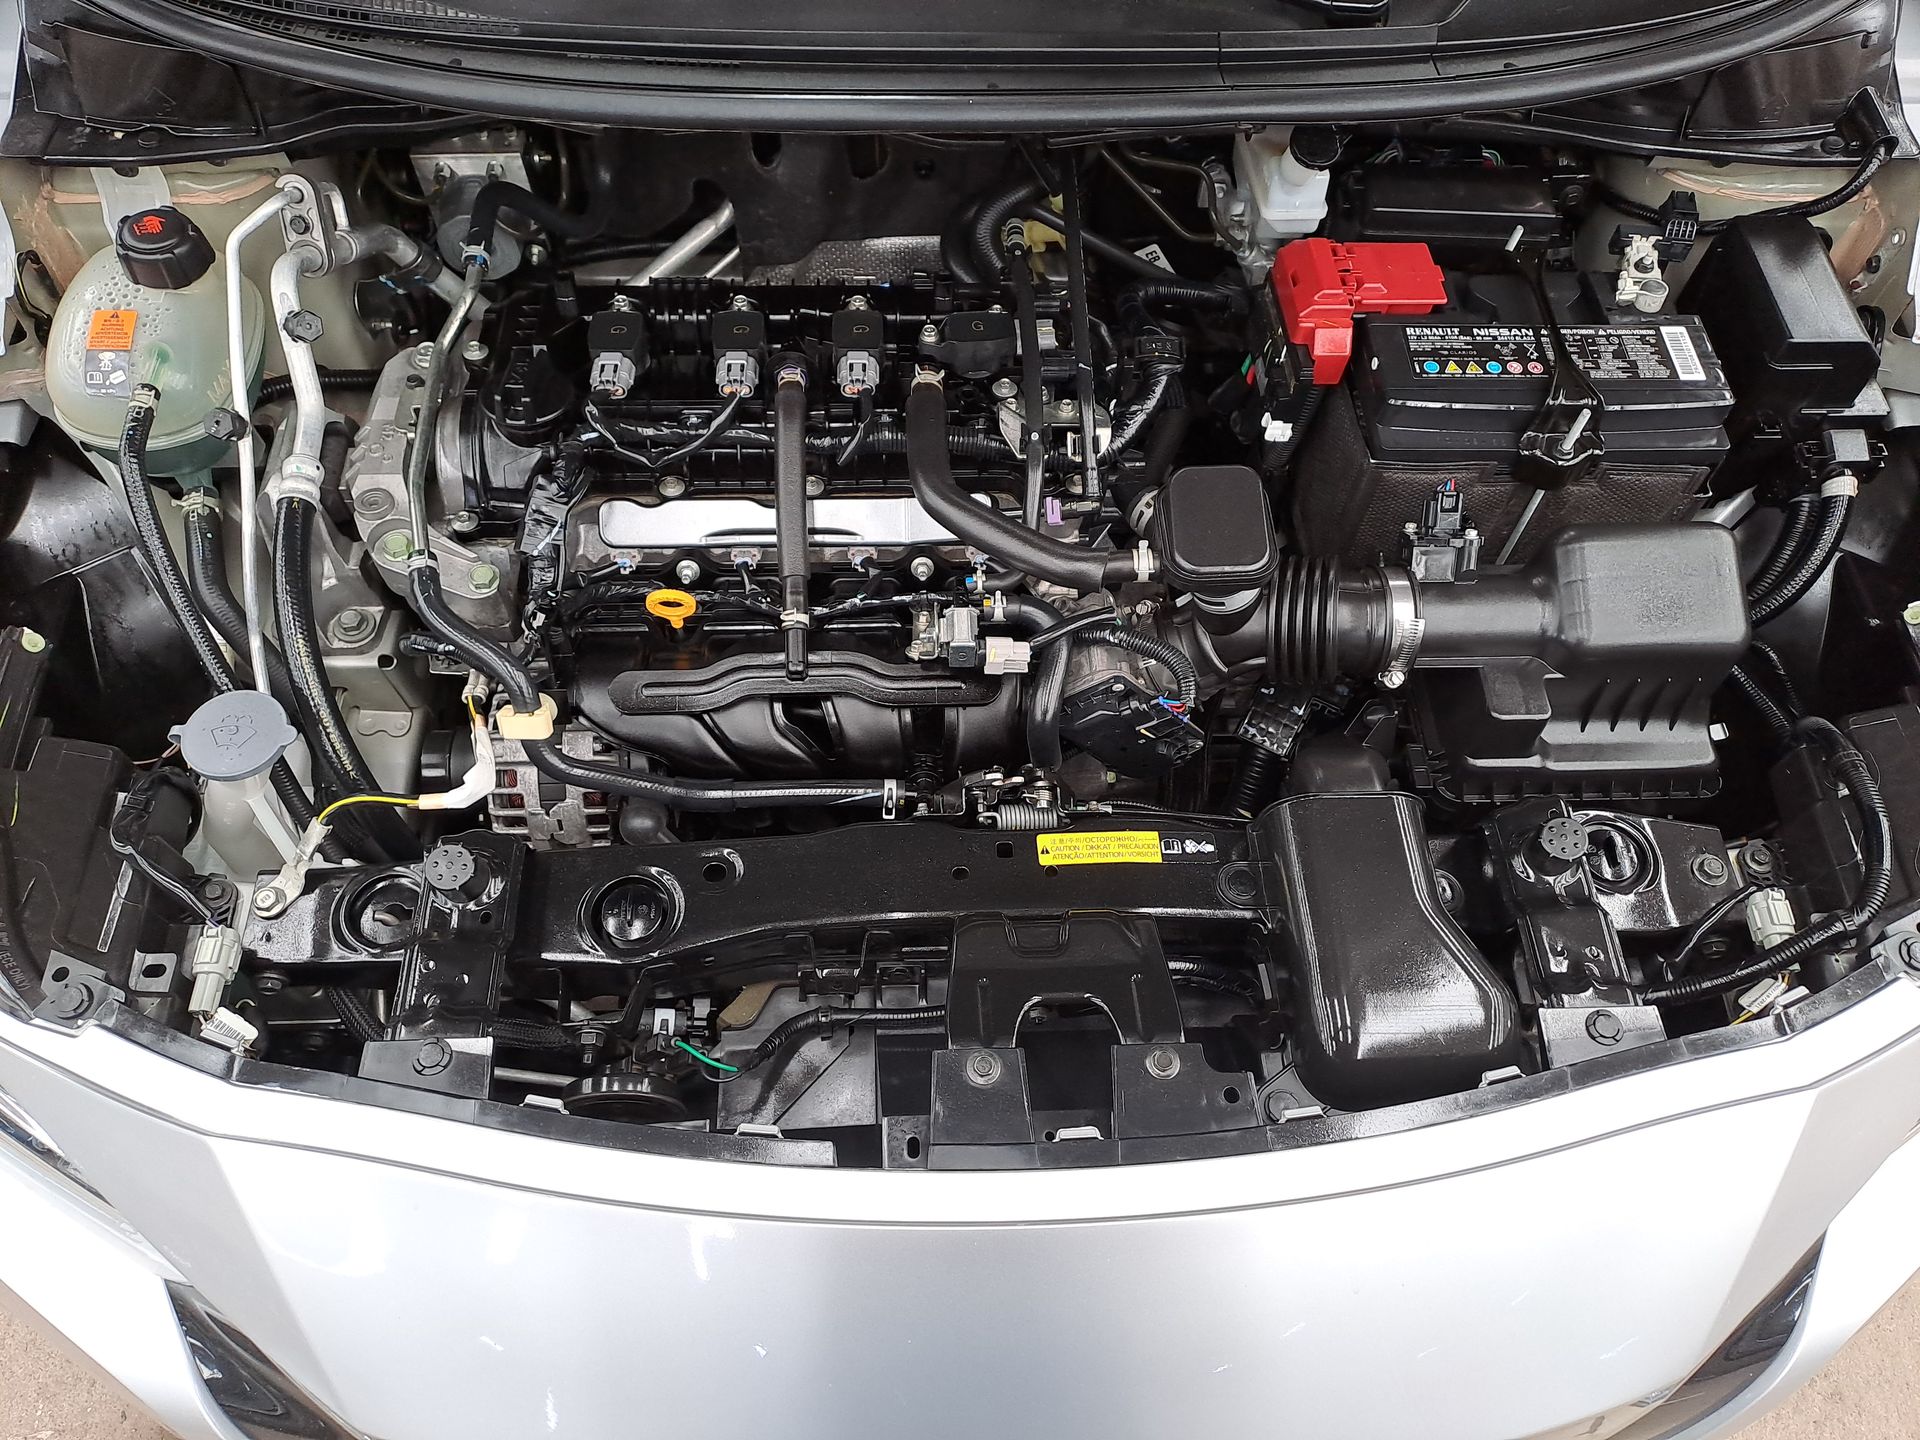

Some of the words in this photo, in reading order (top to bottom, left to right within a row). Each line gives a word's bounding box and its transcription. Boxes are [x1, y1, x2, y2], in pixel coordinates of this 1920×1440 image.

[972, 320, 984, 331] G
[1405, 327, 1460, 335] RENAULT
[1472, 328, 1534, 336] NISSAN
[1050, 844, 1080, 852] CAUTION
[9, 968, 31, 991] ONLY)
